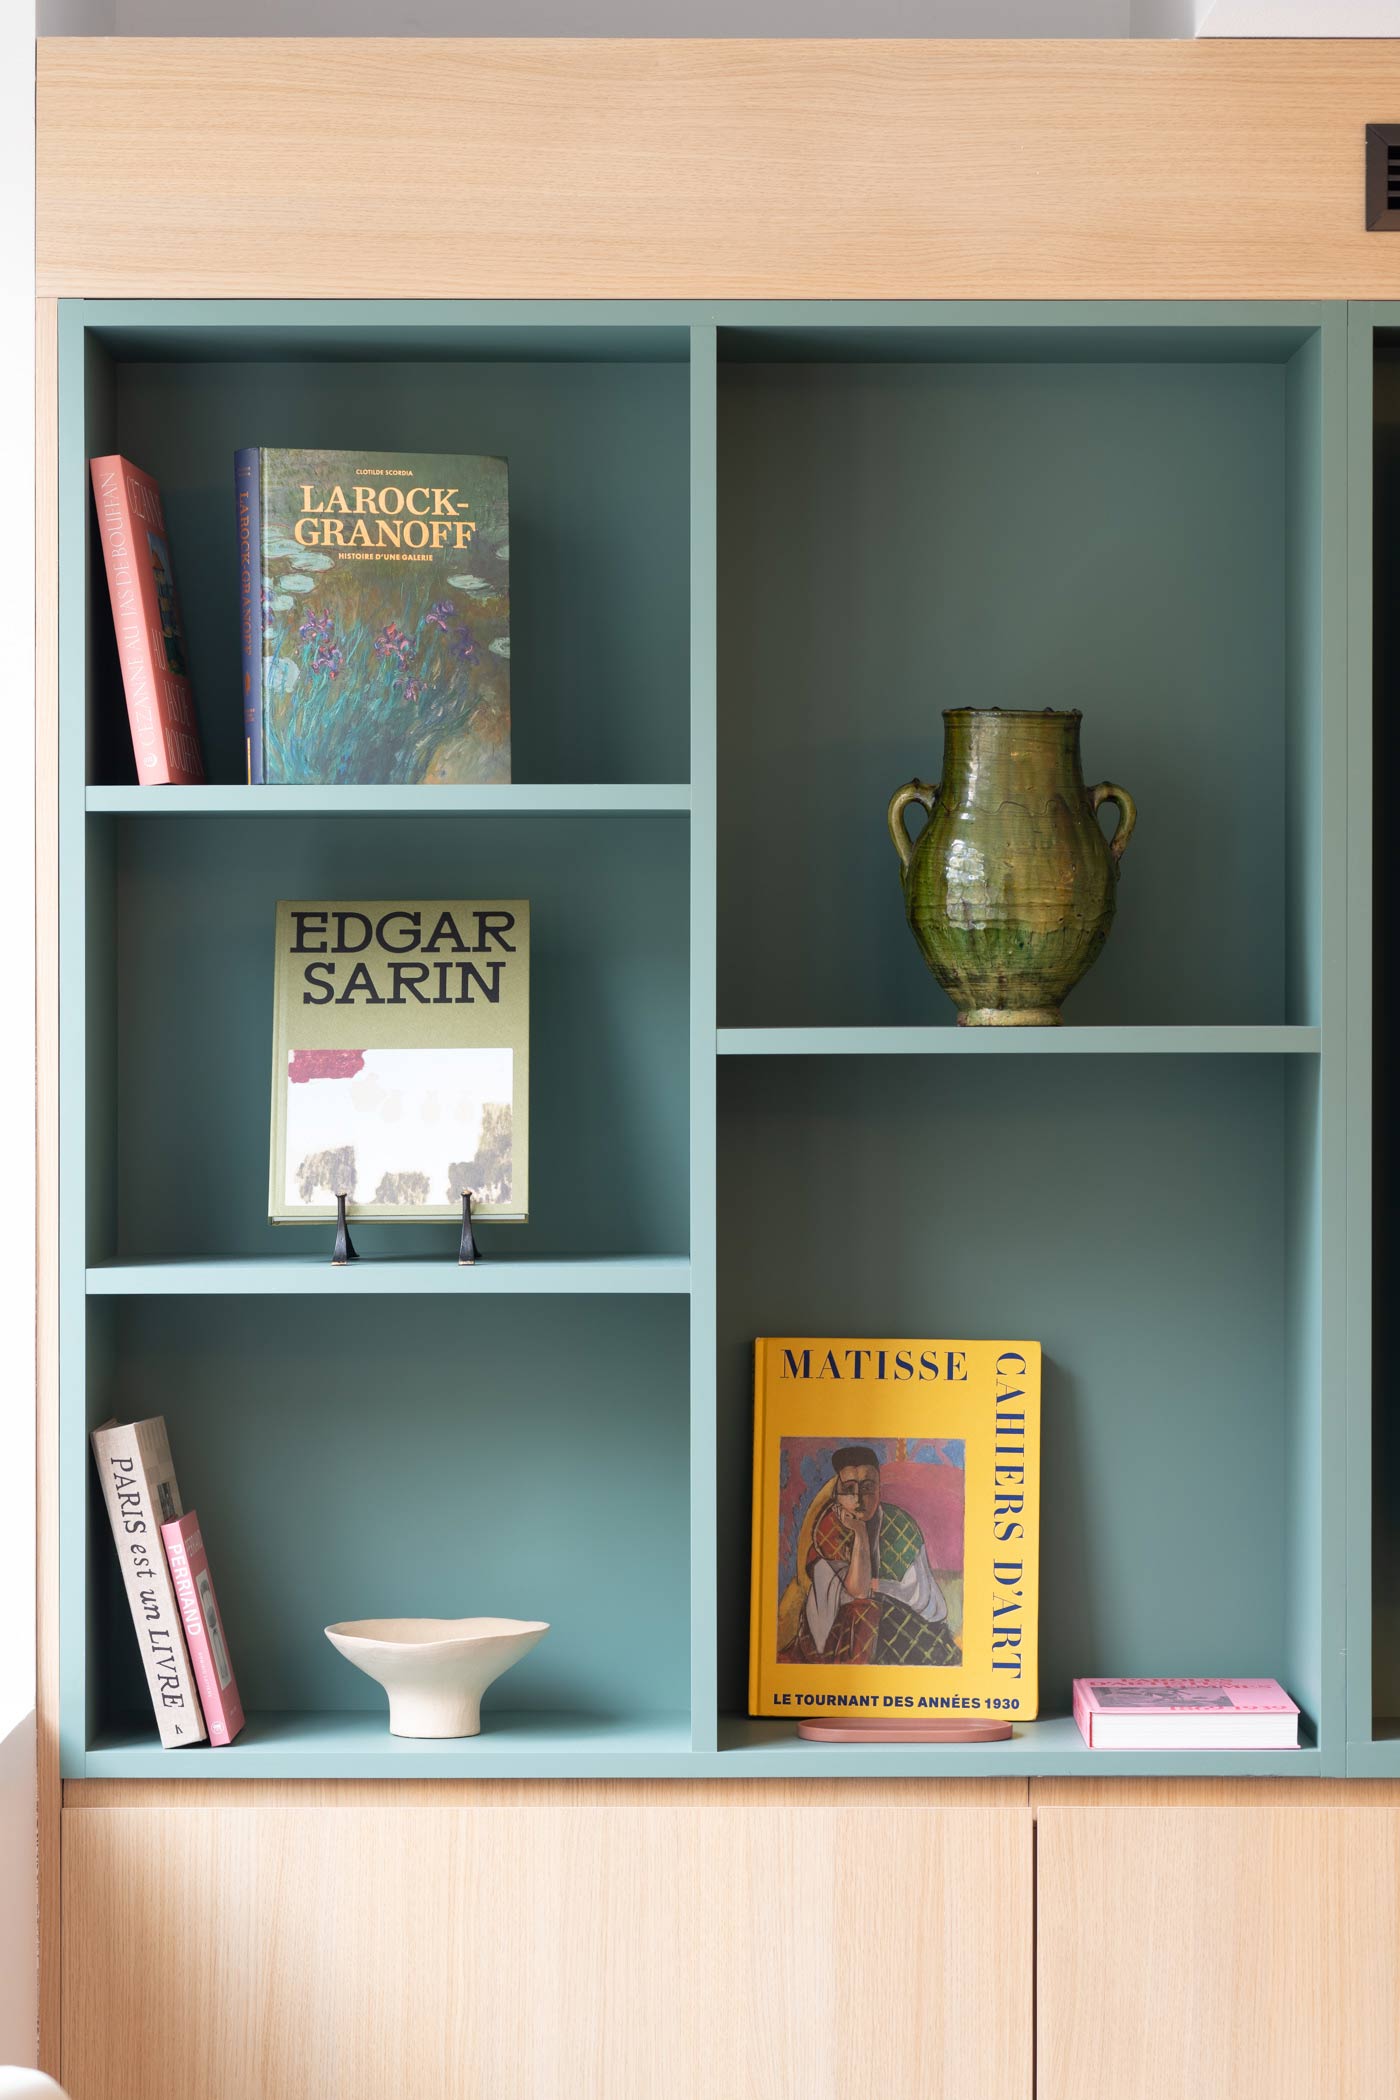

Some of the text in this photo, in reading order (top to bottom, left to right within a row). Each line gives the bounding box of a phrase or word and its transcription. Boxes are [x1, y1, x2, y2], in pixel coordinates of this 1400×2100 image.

[101, 471, 127, 558] BOUFFAN
[300, 485, 469, 516] LAROCK-
[294, 517, 477, 549] GRANOFF
[115, 562, 132, 591] DE
[123, 623, 140, 650] AU
[290, 911, 517, 953] EDGAR
[303, 961, 506, 1005] SARIN
[780, 1349, 968, 1382] MATISSE
[991, 1352, 1027, 1679] CAHIERS D'ART
[110, 1457, 185, 1708] PARIS est un LIVRE
[168, 1544, 202, 1636] PERRIAND
[773, 1693, 1020, 1710] LE TOURNANT DES ANNÉES 1930
